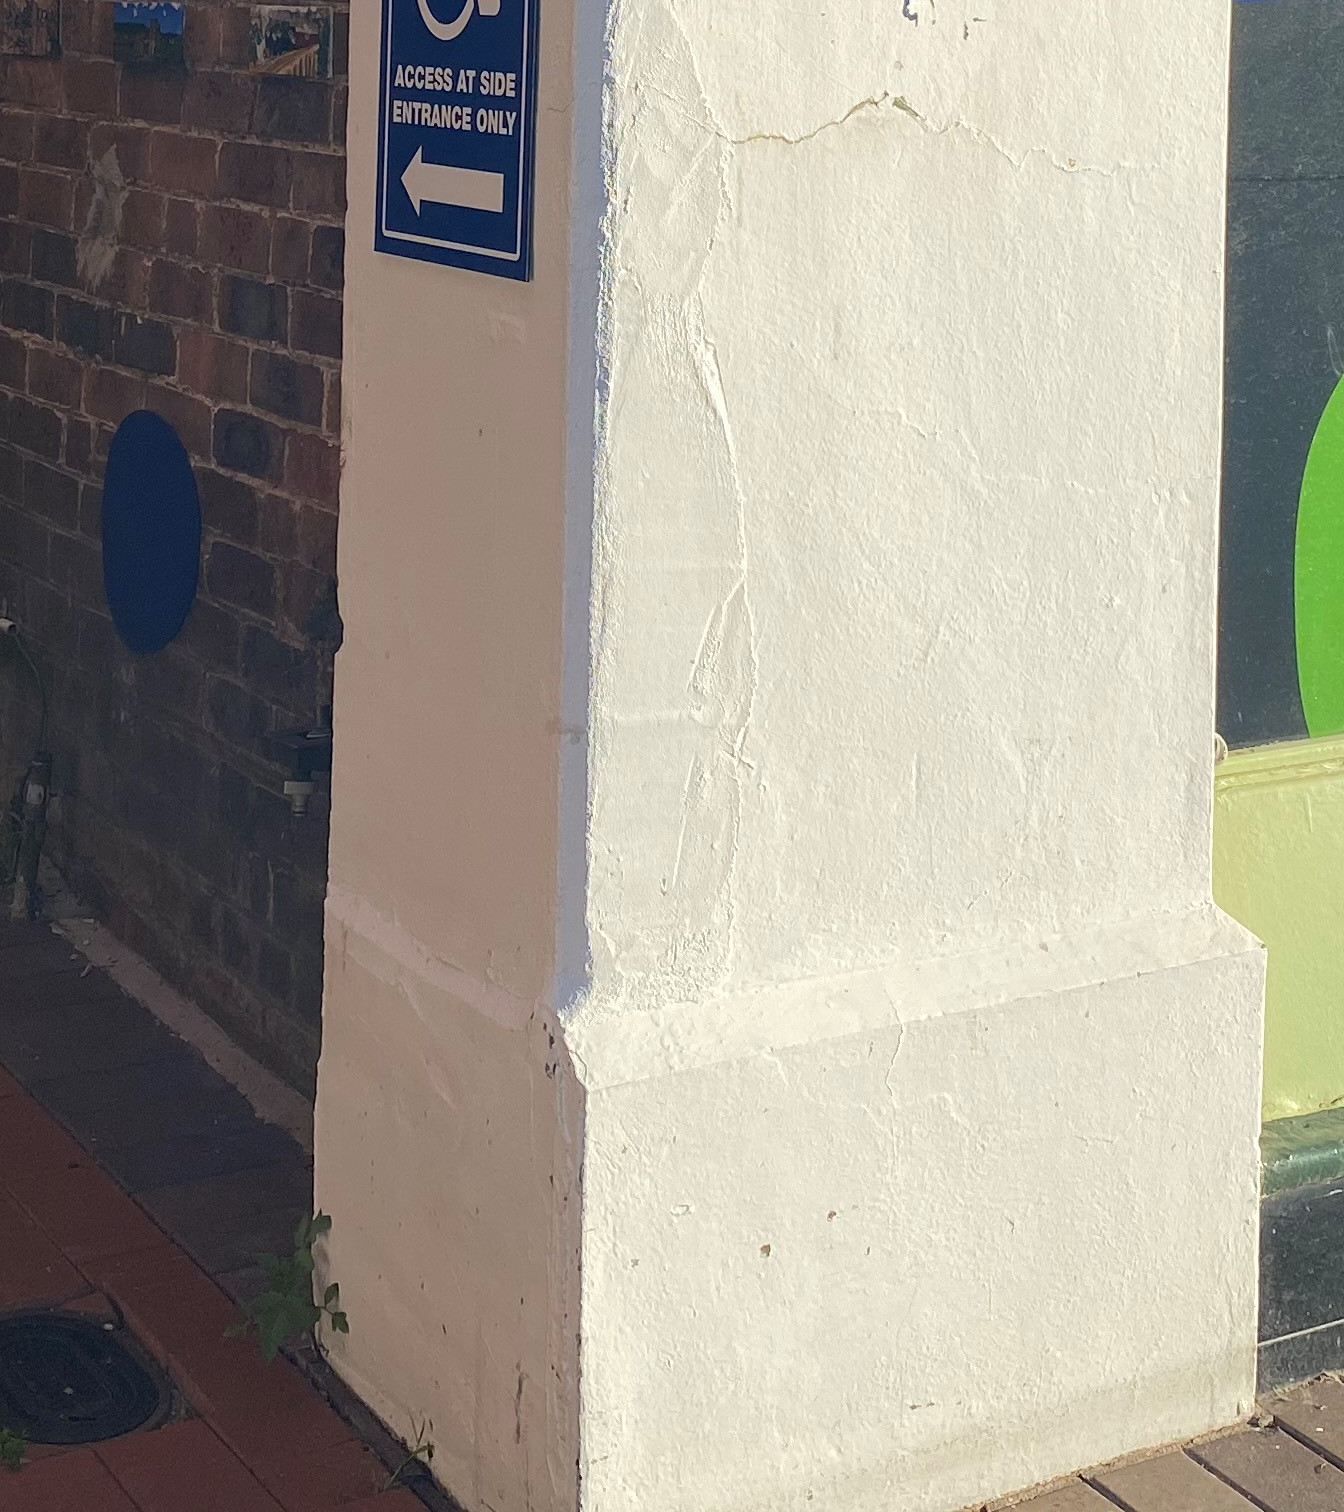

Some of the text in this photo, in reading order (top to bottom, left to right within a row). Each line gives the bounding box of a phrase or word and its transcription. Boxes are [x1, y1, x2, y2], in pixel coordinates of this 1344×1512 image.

[394, 64, 516, 97] ACCESS AT SIDE
[392, 99, 517, 135] ENTRANCE ONLY
